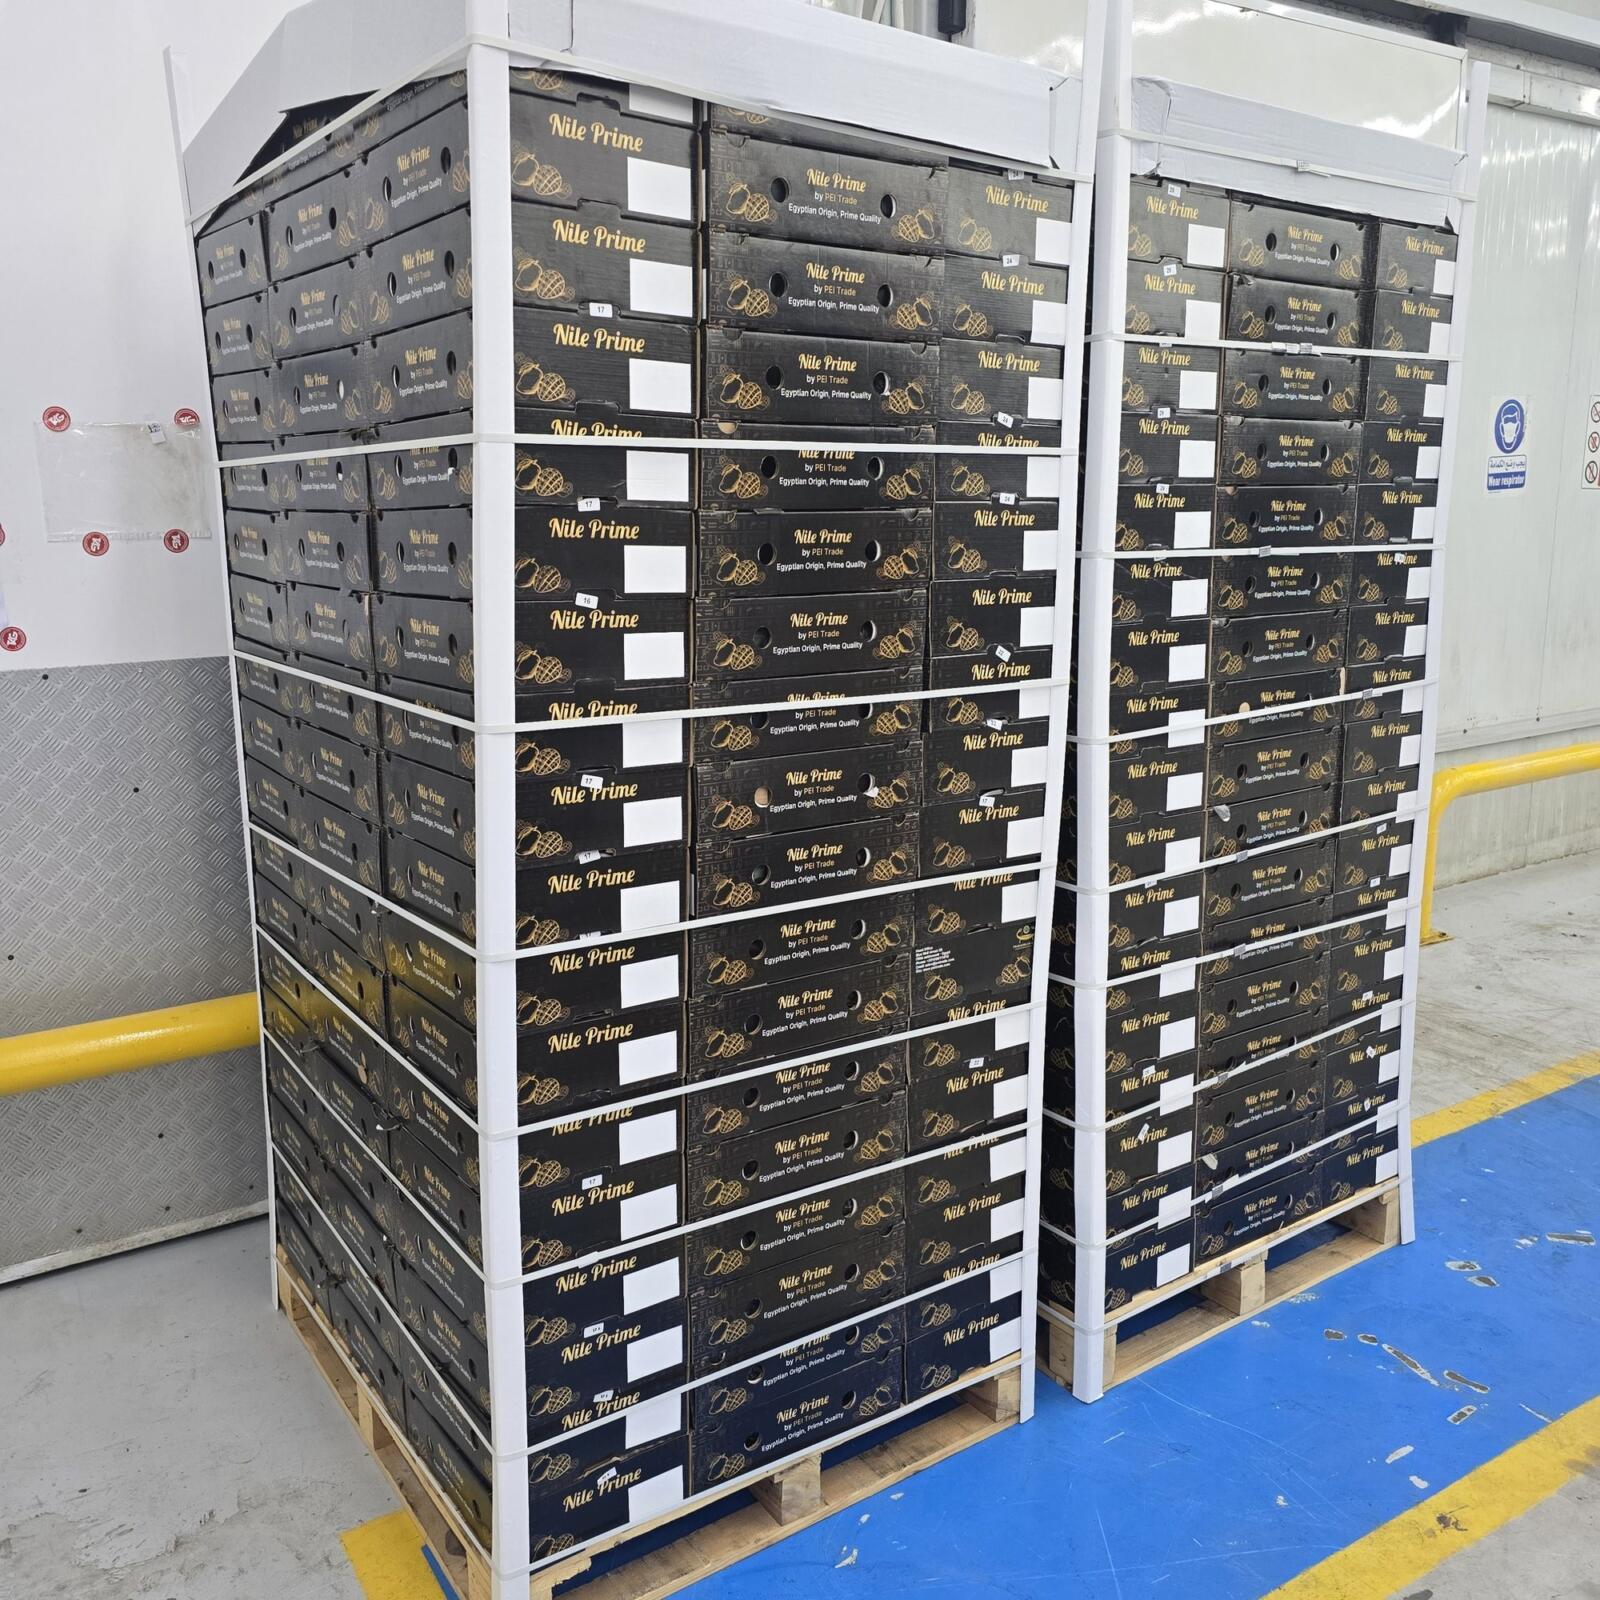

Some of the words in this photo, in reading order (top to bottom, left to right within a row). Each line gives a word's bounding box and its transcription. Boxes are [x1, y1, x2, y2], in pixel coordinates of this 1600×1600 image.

[549, 113, 586, 141] Nile
[591, 122, 643, 152] Prime
[807, 169, 830, 187] Nile
[832, 174, 866, 193] Prime
[814, 191, 824, 202] by
[825, 192, 836, 202] PEI
[837, 194, 858, 205] Trade
[986, 185, 1010, 206] Nile
[1013, 192, 1048, 212] Prime
[1146, 196, 1167, 214] Nile
[1169, 199, 1198, 219] Prime
[788, 202, 817, 215] Egyptian
[818, 207, 839, 219] Origin,
[840, 210, 858, 220] Prime
[859, 212, 883, 225] Quality
[553, 219, 589, 245] Nile
[595, 226, 646, 253] Prime
[806, 263, 829, 280] Nile
[831, 266, 865, 283] Prime
[982, 271, 1006, 291] Nile
[1008, 275, 1044, 295] Prime
[814, 284, 823, 295] by
[824, 285, 835, 294] PEI
[836, 286, 856, 296] Trade
[788, 296, 816, 307] Egyptian
[817, 299, 838, 310] Origin,
[839, 301, 857, 311] Prime
[858, 303, 880, 314] Quality
[553, 323, 589, 347] Nile
[594, 328, 645, 353] Prime
[798, 353, 822, 370] Nile
[824, 355, 857, 372] Prime
[978, 351, 1002, 369] Nile
[1005, 353, 1040, 372] Prime
[551, 418, 588, 436] Nile
[591, 421, 642, 437] Prime
[1139, 418, 1159, 434] Nile
[1160, 419, 1190, 436] Prime
[1489, 476, 1502, 486] Wear
[1503, 474, 1524, 487] respirator
[549, 517, 584, 539] Nile
[589, 519, 640, 540] Prime
[974, 510, 998, 527] Nile
[1000, 510, 1035, 526] Prime
[794, 529, 817, 544] Nile
[819, 528, 852, 544] Prime
[802, 548, 811, 558] by
[812, 548, 823, 556] PEI
[824, 547, 844, 556] Trade
[776, 562, 804, 572] Egyptian
[805, 561, 826, 571] Origin,
[845, 560, 867, 569] Quality
[972, 589, 996, 606] Nile
[998, 588, 1032, 604] Prime
[550, 610, 585, 630] Nile
[590, 609, 639, 629] Prime
[790, 613, 813, 628] Nile
[815, 612, 848, 626] Prime
[1375, 612, 1392, 625] Nile
[1392, 611, 1415, 624] Prime
[798, 631, 807, 641] by
[808, 630, 819, 639] PEI
[820, 629, 840, 638] Trade
[772, 645, 801, 656] Egyptian
[801, 644, 822, 653] Origin,
[842, 641, 863, 650] Quality
[971, 664, 995, 680] Nile
[997, 662, 1030, 677] Prime
[549, 702, 584, 720] Nile
[588, 700, 638, 717] Prime
[1126, 698, 1148, 714] Nile
[1149, 696, 1178, 710] Prime
[963, 734, 987, 751] Nile
[989, 732, 1024, 746] Prime
[786, 771, 808, 786] Nile
[810, 768, 842, 781] Prime
[551, 786, 585, 805] Nile
[592, 784, 638, 801] Prime
[794, 789, 803, 798] by
[804, 786, 814, 795] PEI
[816, 784, 834, 793] Trade
[768, 802, 796, 814] Egyptian
[797, 799, 817, 809] Origin,
[818, 798, 836, 806] Prime
[836, 794, 858, 803] Quality
[959, 808, 983, 824] Nile
[985, 806, 1019, 820] Prime
[548, 874, 582, 894] Nile
[586, 870, 635, 886] Prime
[780, 924, 802, 938] Nile
[804, 919, 836, 931] Prime
[788, 940, 797, 949] by
[798, 937, 808, 946] PEI
[810, 934, 828, 943] Trade
[1354, 944, 1370, 957] Nile
[1370, 939, 1392, 952] Prime
[550, 953, 584, 973] Nile
[588, 946, 635, 966] Prime
[764, 954, 791, 966] Egyptian
[791, 950, 811, 959] Origin,
[812, 946, 829, 954] Prime
[830, 942, 851, 951] Quality
[1121, 1018, 1141, 1033] Nile
[1142, 1012, 1169, 1026] Prime
[548, 1032, 582, 1052] Nile
[586, 1023, 633, 1045] Prime
[946, 1076, 969, 1094] Nile
[971, 1067, 1004, 1086] Prime
[775, 1140, 797, 1154] Nile
[798, 1131, 830, 1146] Prime
[782, 1156, 791, 1164] by
[792, 1152, 802, 1160] PEI
[804, 1147, 822, 1157] Trade
[759, 1169, 786, 1183] Egyptian
[786, 1163, 806, 1174] Origin,
[806, 1158, 824, 1168] Prime
[824, 1151, 845, 1162] Quality
[552, 1194, 584, 1214] Nile
[588, 1180, 634, 1205] Prime
[943, 1204, 966, 1220] Nile
[968, 1193, 1001, 1212] Prime
[776, 1208, 797, 1223] Nile
[799, 1199, 830, 1218] Prime
[556, 1272, 587, 1292] Nile
[591, 1256, 637, 1280] Prime
[943, 1328, 966, 1346] Nile
[968, 1313, 999, 1332] Prime
[562, 1343, 592, 1362] Nile
[596, 1325, 640, 1350] Prime
[560, 1406, 592, 1431] Nile
[596, 1392, 640, 1418] Prime
[776, 1408, 797, 1424] Nile
[800, 1395, 829, 1414] Prime
